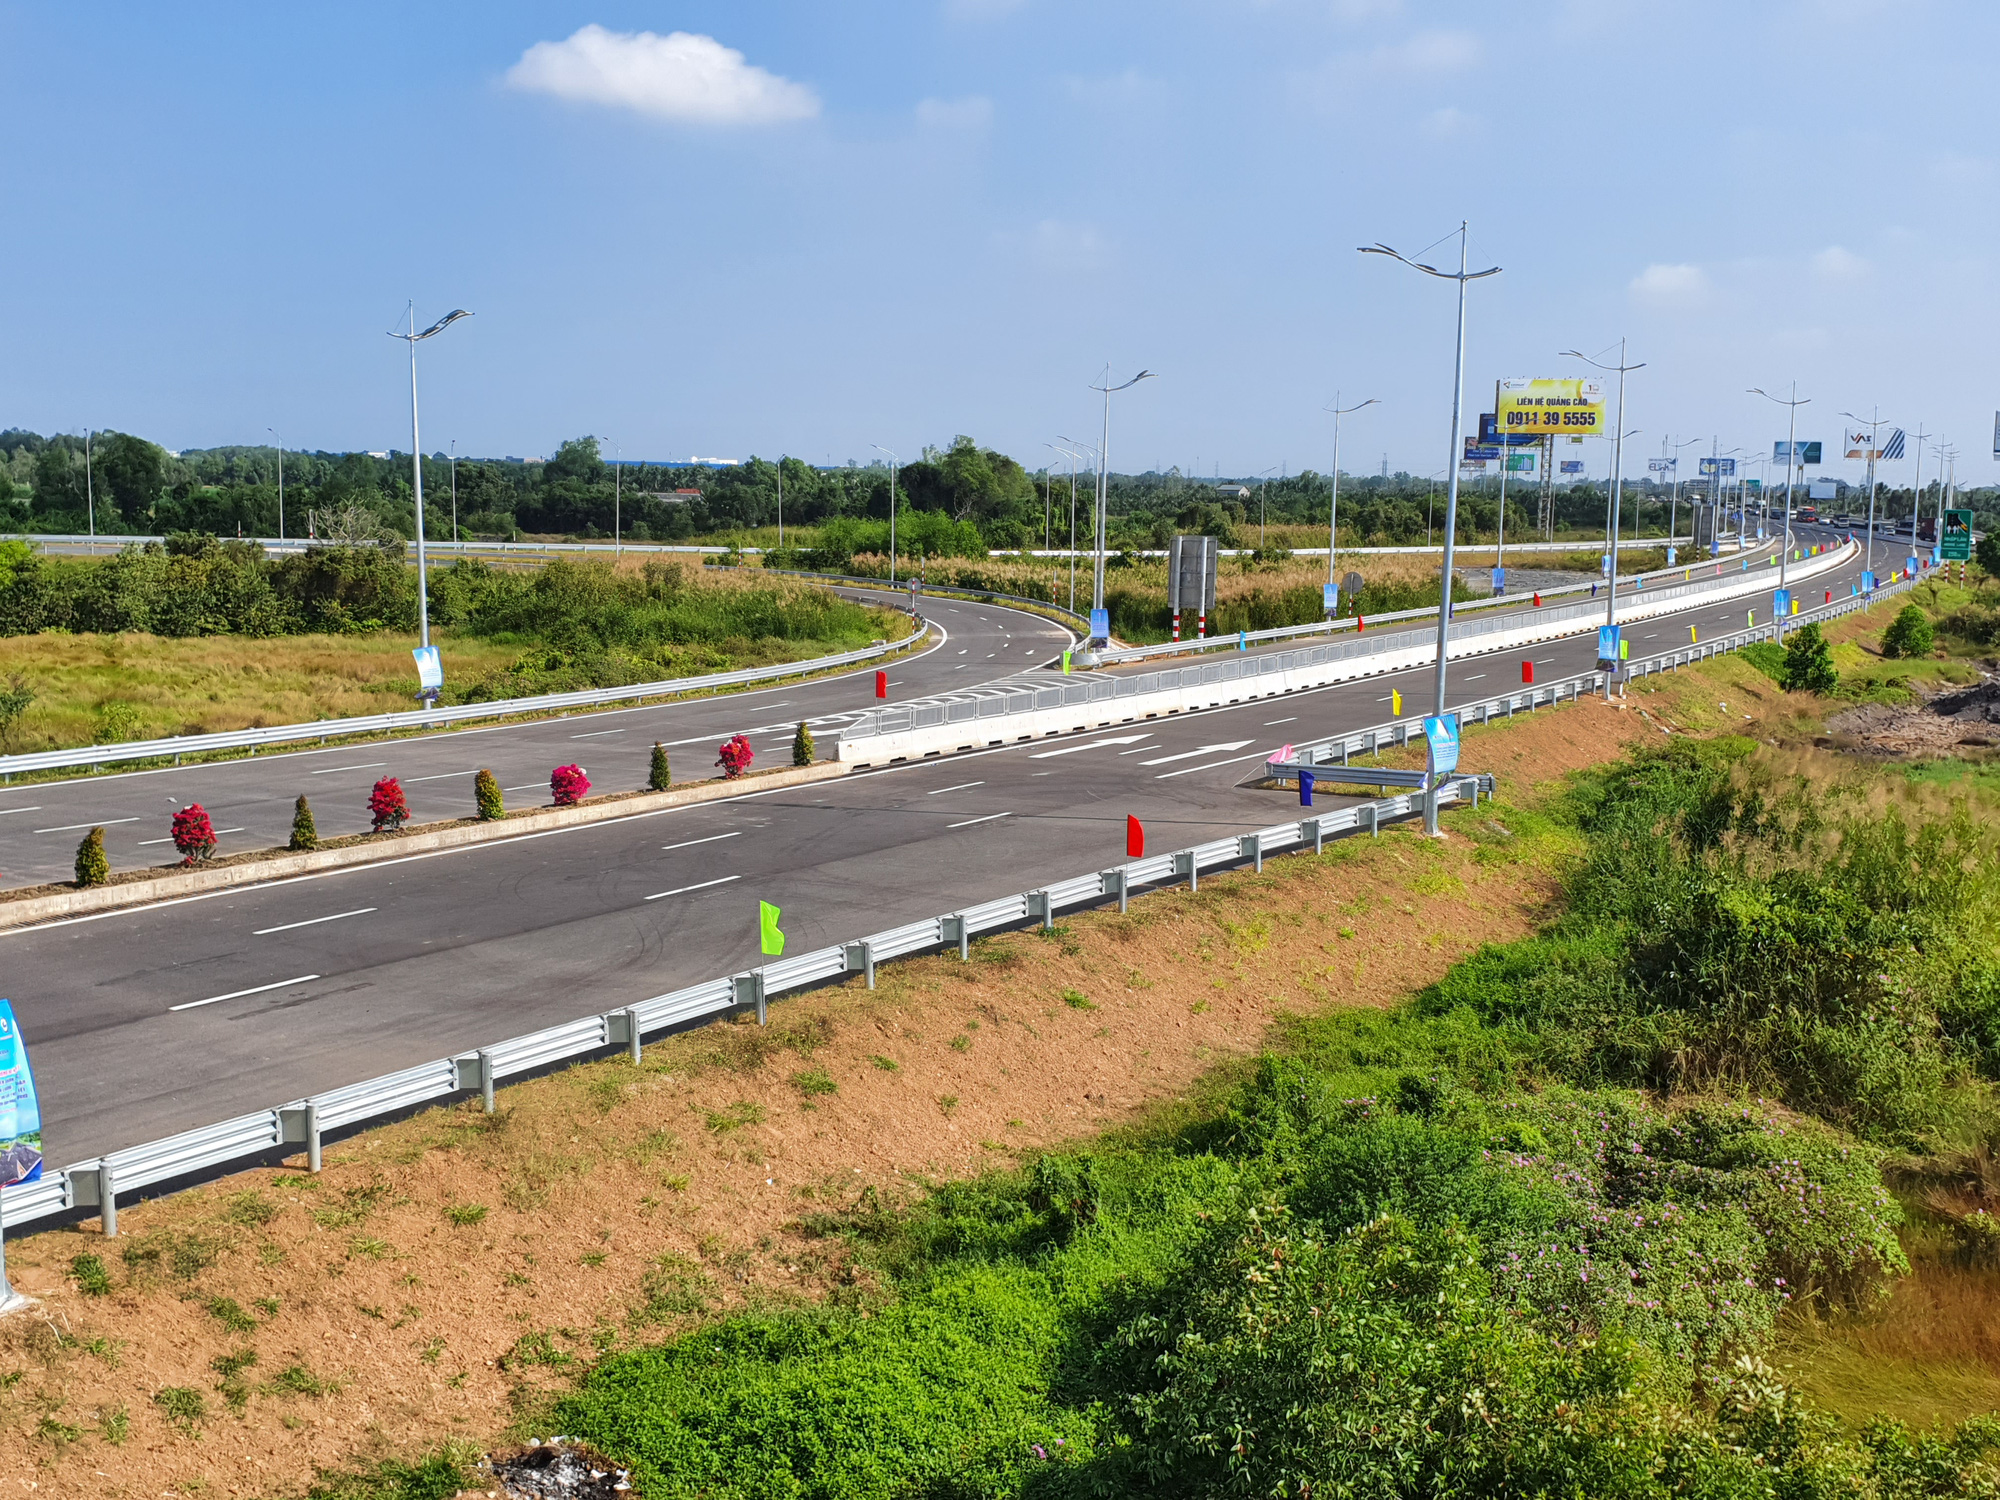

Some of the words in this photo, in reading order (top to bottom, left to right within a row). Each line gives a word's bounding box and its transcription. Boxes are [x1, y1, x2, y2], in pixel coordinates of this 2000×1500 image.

[1517, 396, 1533, 406] LIÊN
[1535, 396, 1544, 407] HỆ
[1546, 395, 1571, 406] QUẢNG
[1507, 411, 1539, 425] 0911
[1543, 411, 1560, 425] 39
[1563, 411, 1596, 425] 5555
